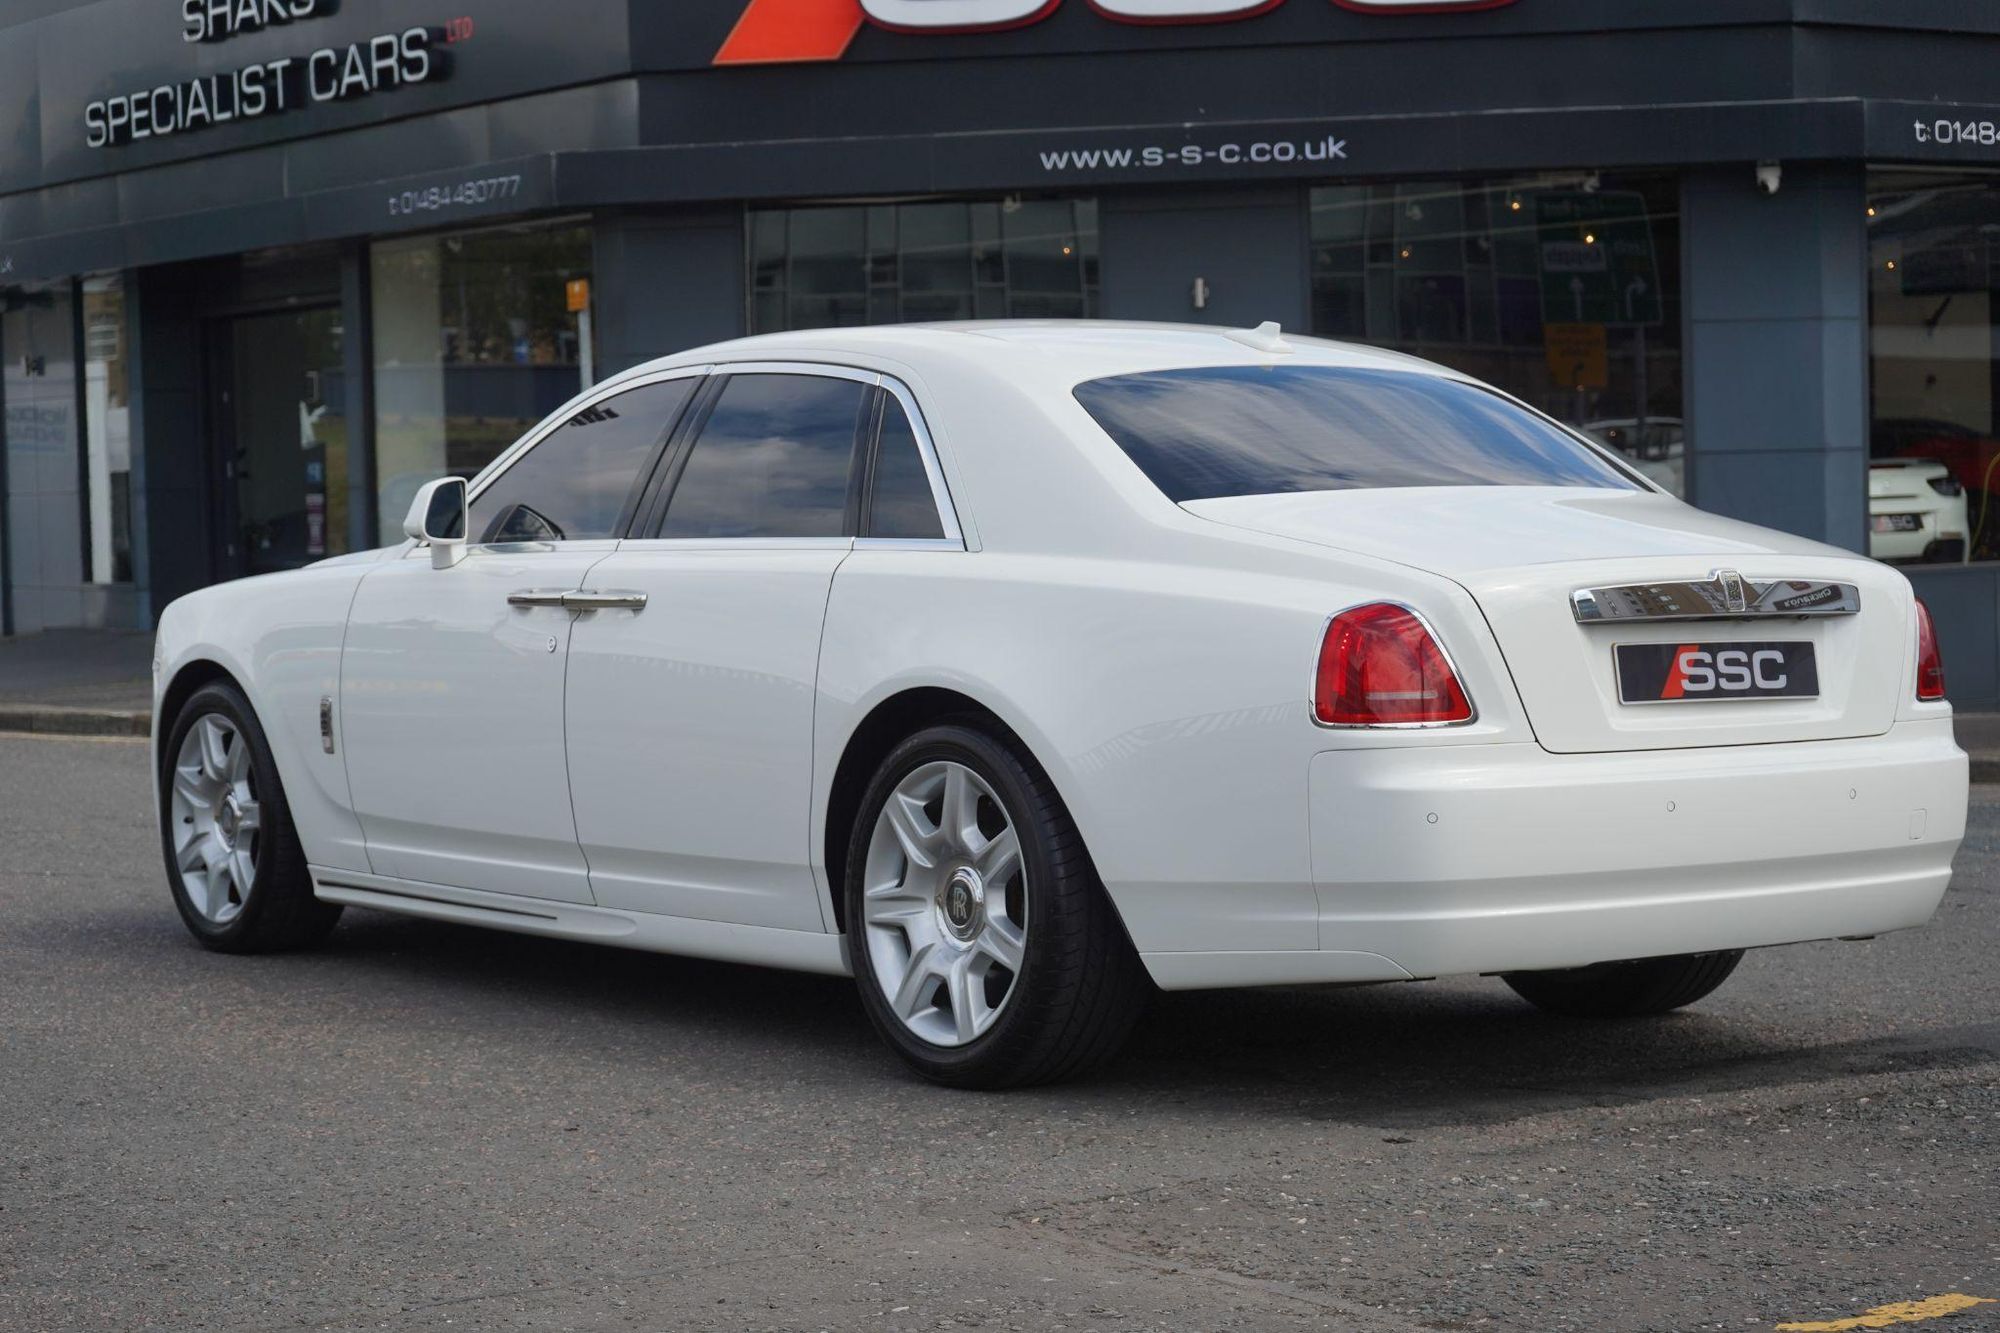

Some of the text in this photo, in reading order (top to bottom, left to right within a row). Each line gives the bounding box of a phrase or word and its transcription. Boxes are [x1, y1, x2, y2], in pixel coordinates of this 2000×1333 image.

[85, 16, 474, 148] SPECIALIST CARS LTD
[1913, 118, 2000, 145] t:0148
[1039, 136, 1347, 170] www.s-s-c.co.uk
[1678, 649, 1787, 691] SSC
